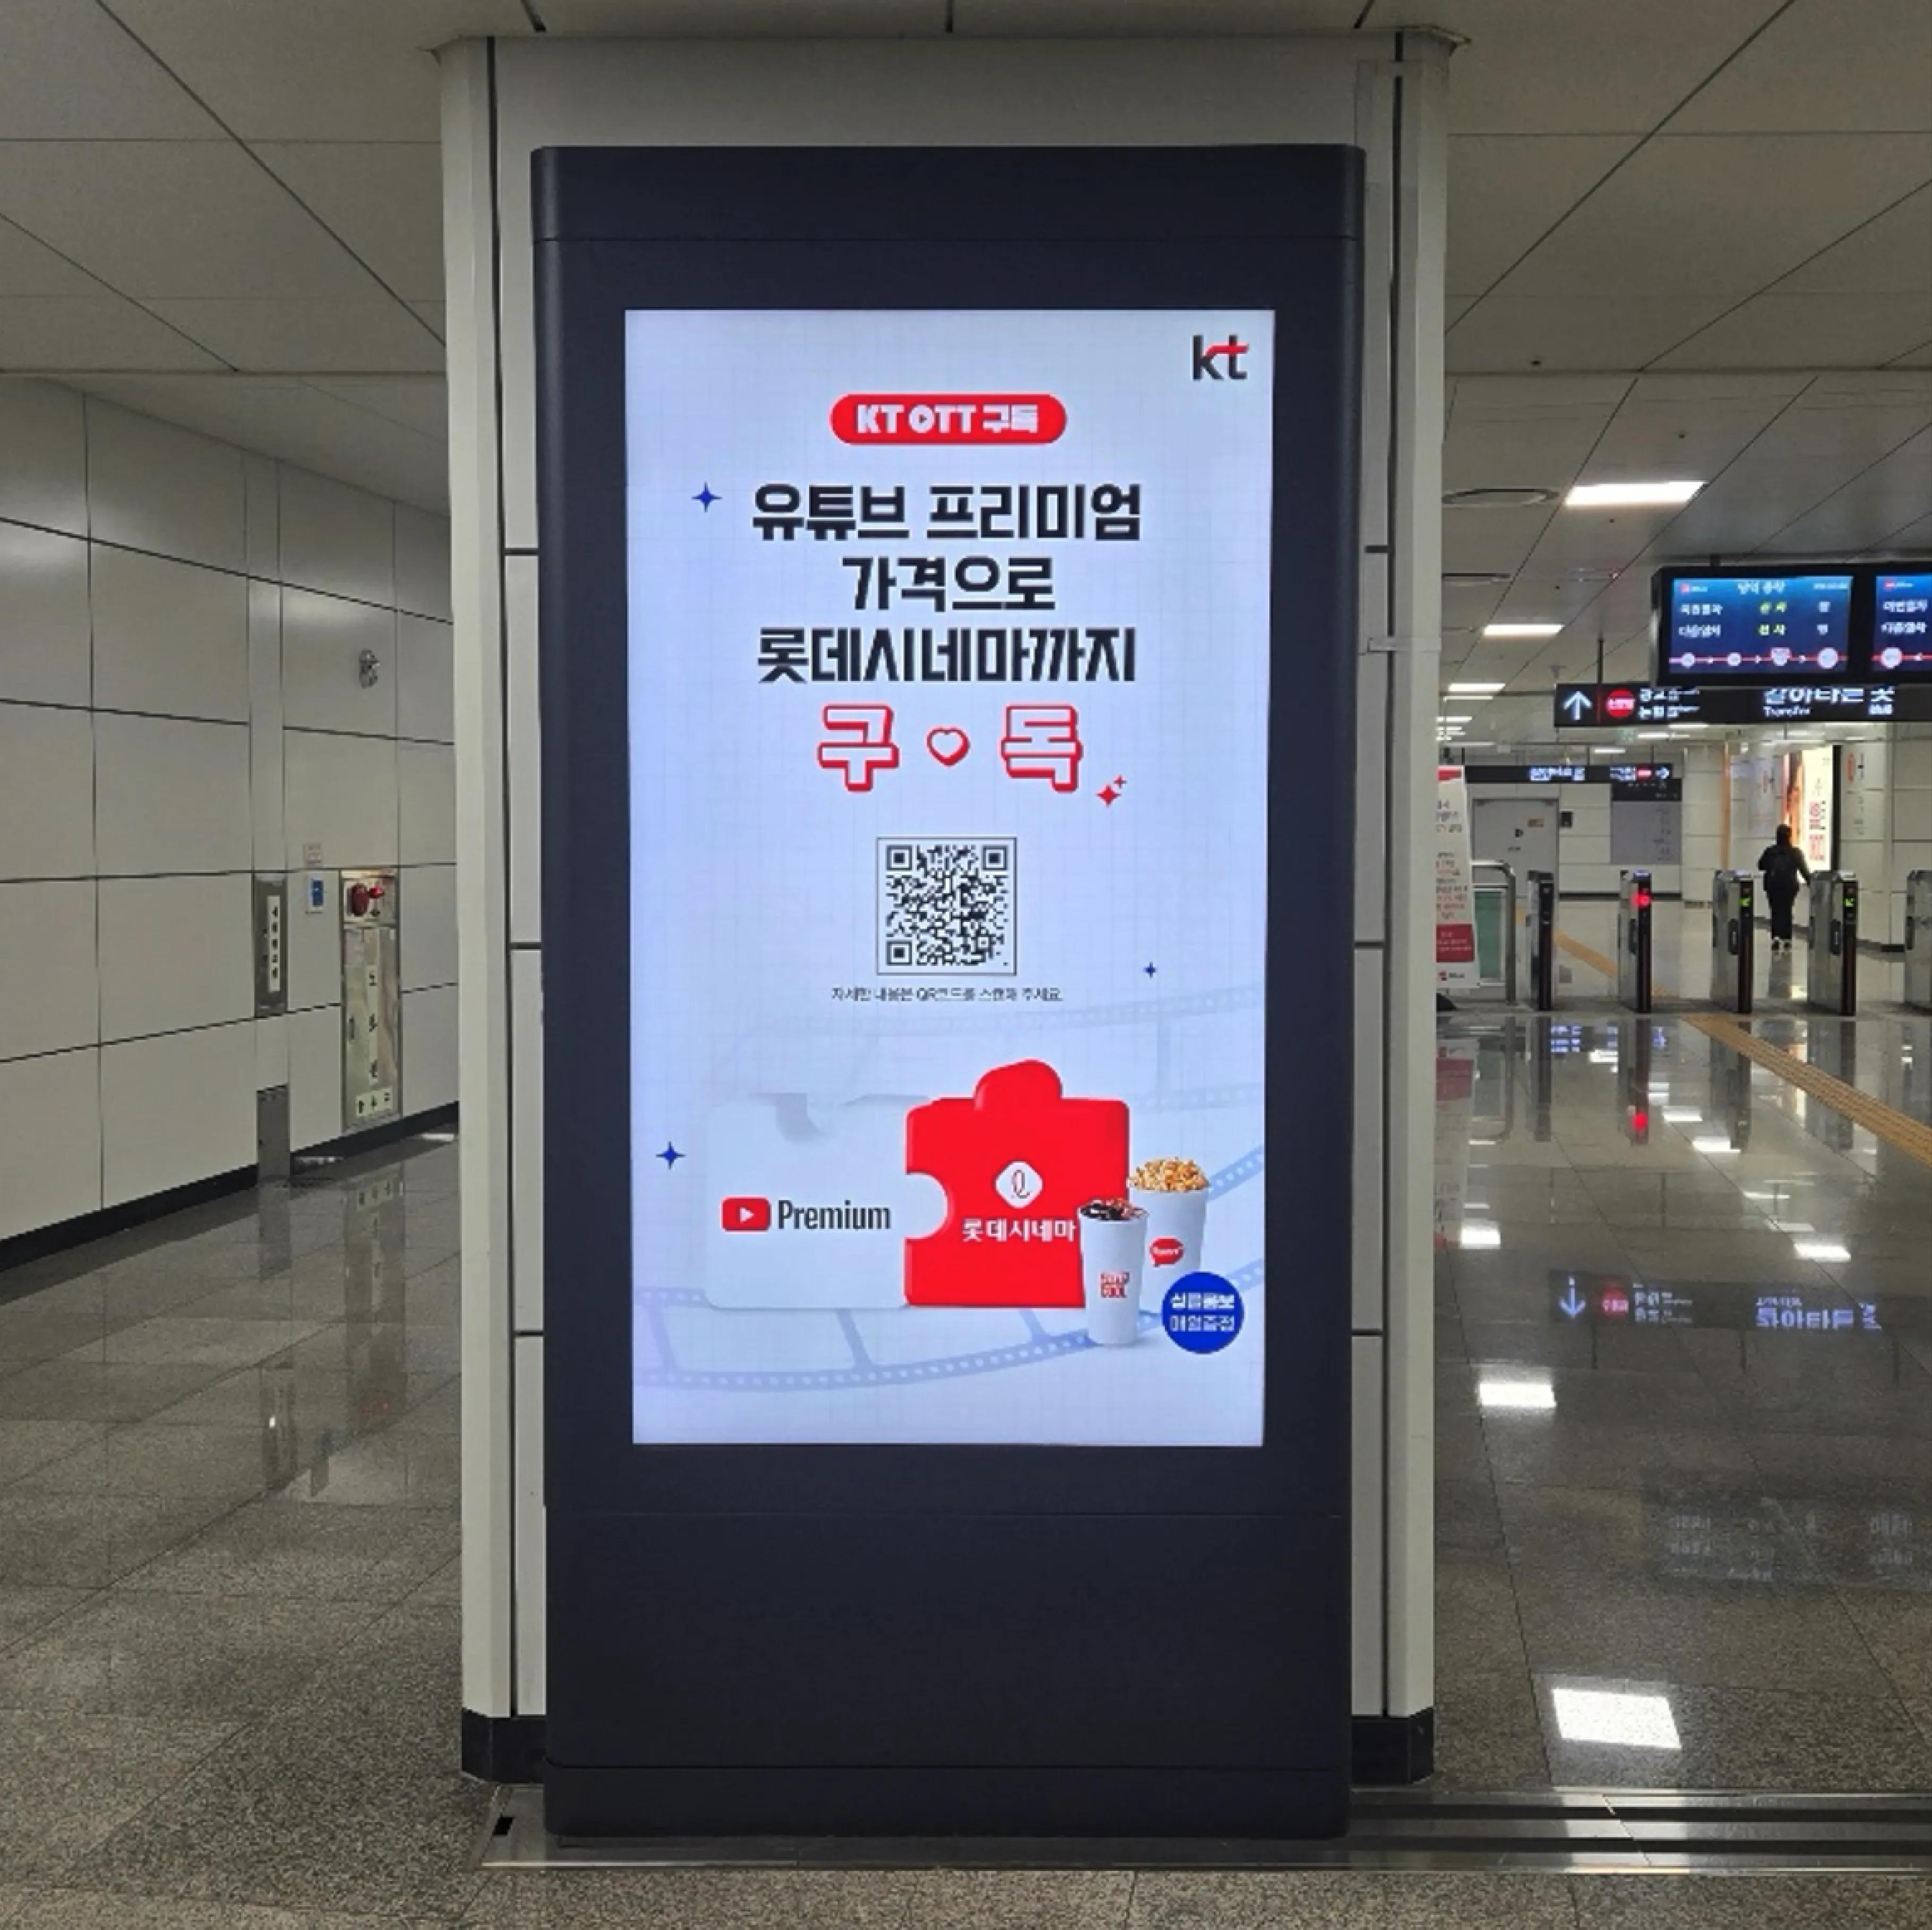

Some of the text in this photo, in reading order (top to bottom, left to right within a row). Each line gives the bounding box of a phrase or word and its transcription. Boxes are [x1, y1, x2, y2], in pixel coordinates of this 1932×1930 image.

[1192, 334, 1248, 380] kt
[857, 403, 1038, 434] KT OTT 구독
[752, 482, 1141, 541] 유튜브 프리미엄
[842, 556, 1055, 613] 가격으로
[758, 627, 1136, 683] 롯데시네마까지
[831, 987, 872, 1002] 자세한
[875, 987, 913, 1002] 내용은
[916, 987, 975, 1002] QR코드를
[778, 1199, 891, 1230] Premium
[961, 1218, 1076, 1242] 롯데시네마
